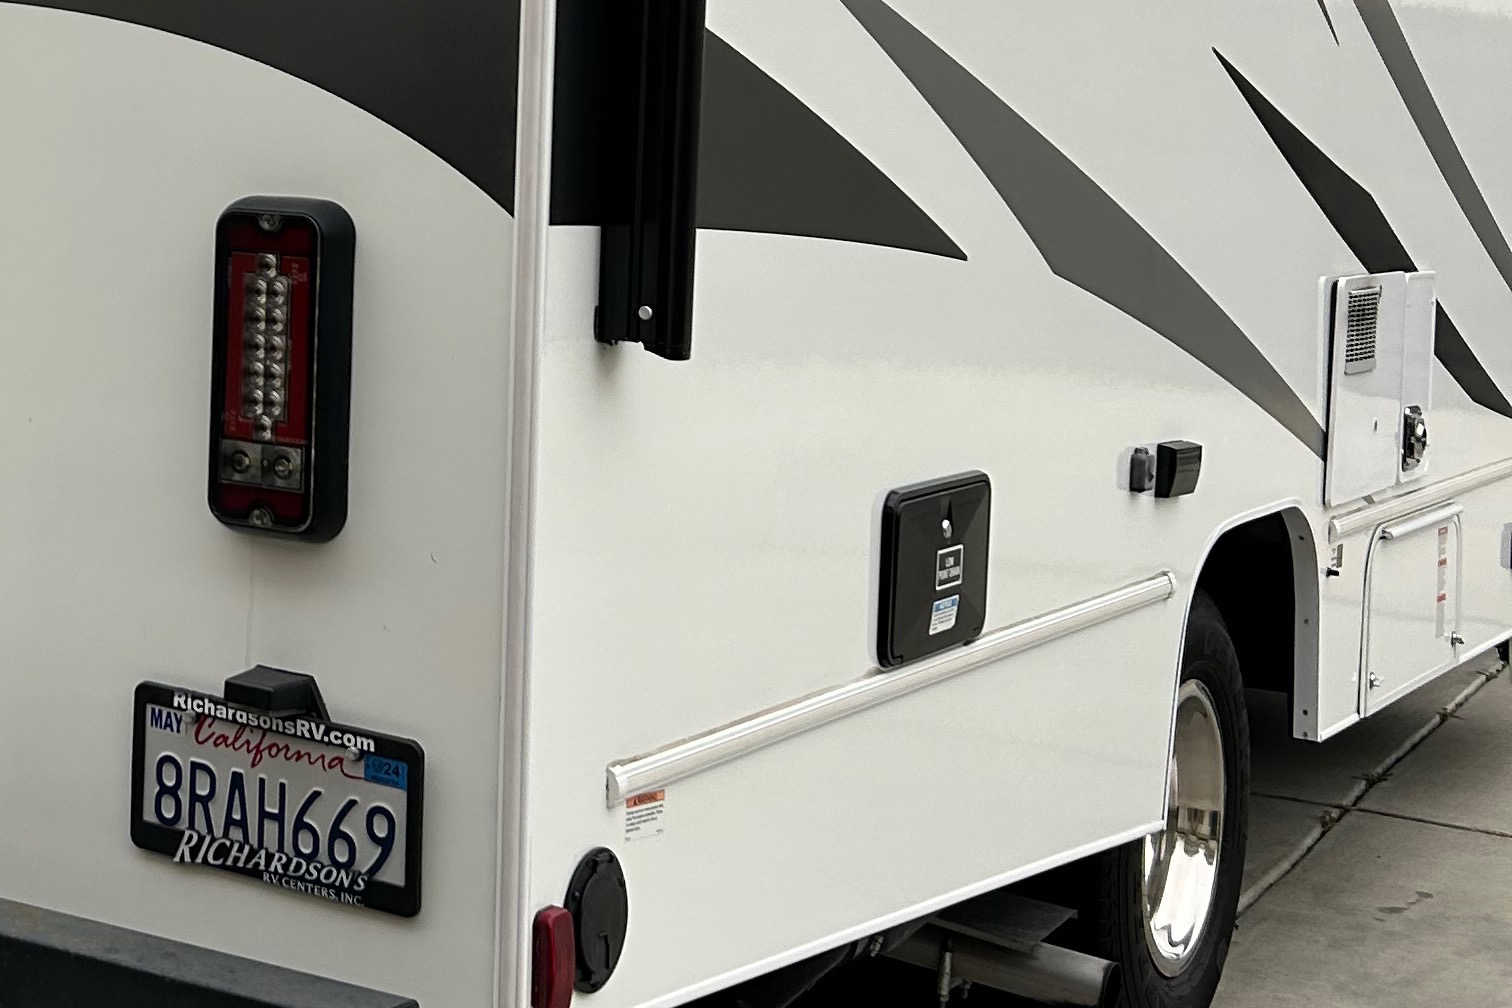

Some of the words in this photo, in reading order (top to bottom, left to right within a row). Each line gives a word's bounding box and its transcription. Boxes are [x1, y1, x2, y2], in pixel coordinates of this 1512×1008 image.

[150, 706, 183, 734] MAY
[194, 712, 366, 781] California
[173, 690, 376, 753] RichardsonsRV.com
[383, 761, 400, 778] 24
[154, 753, 397, 876] 8RAH669
[173, 828, 370, 892] RICHARDSON'S
[340, 892, 365, 907] INC.
